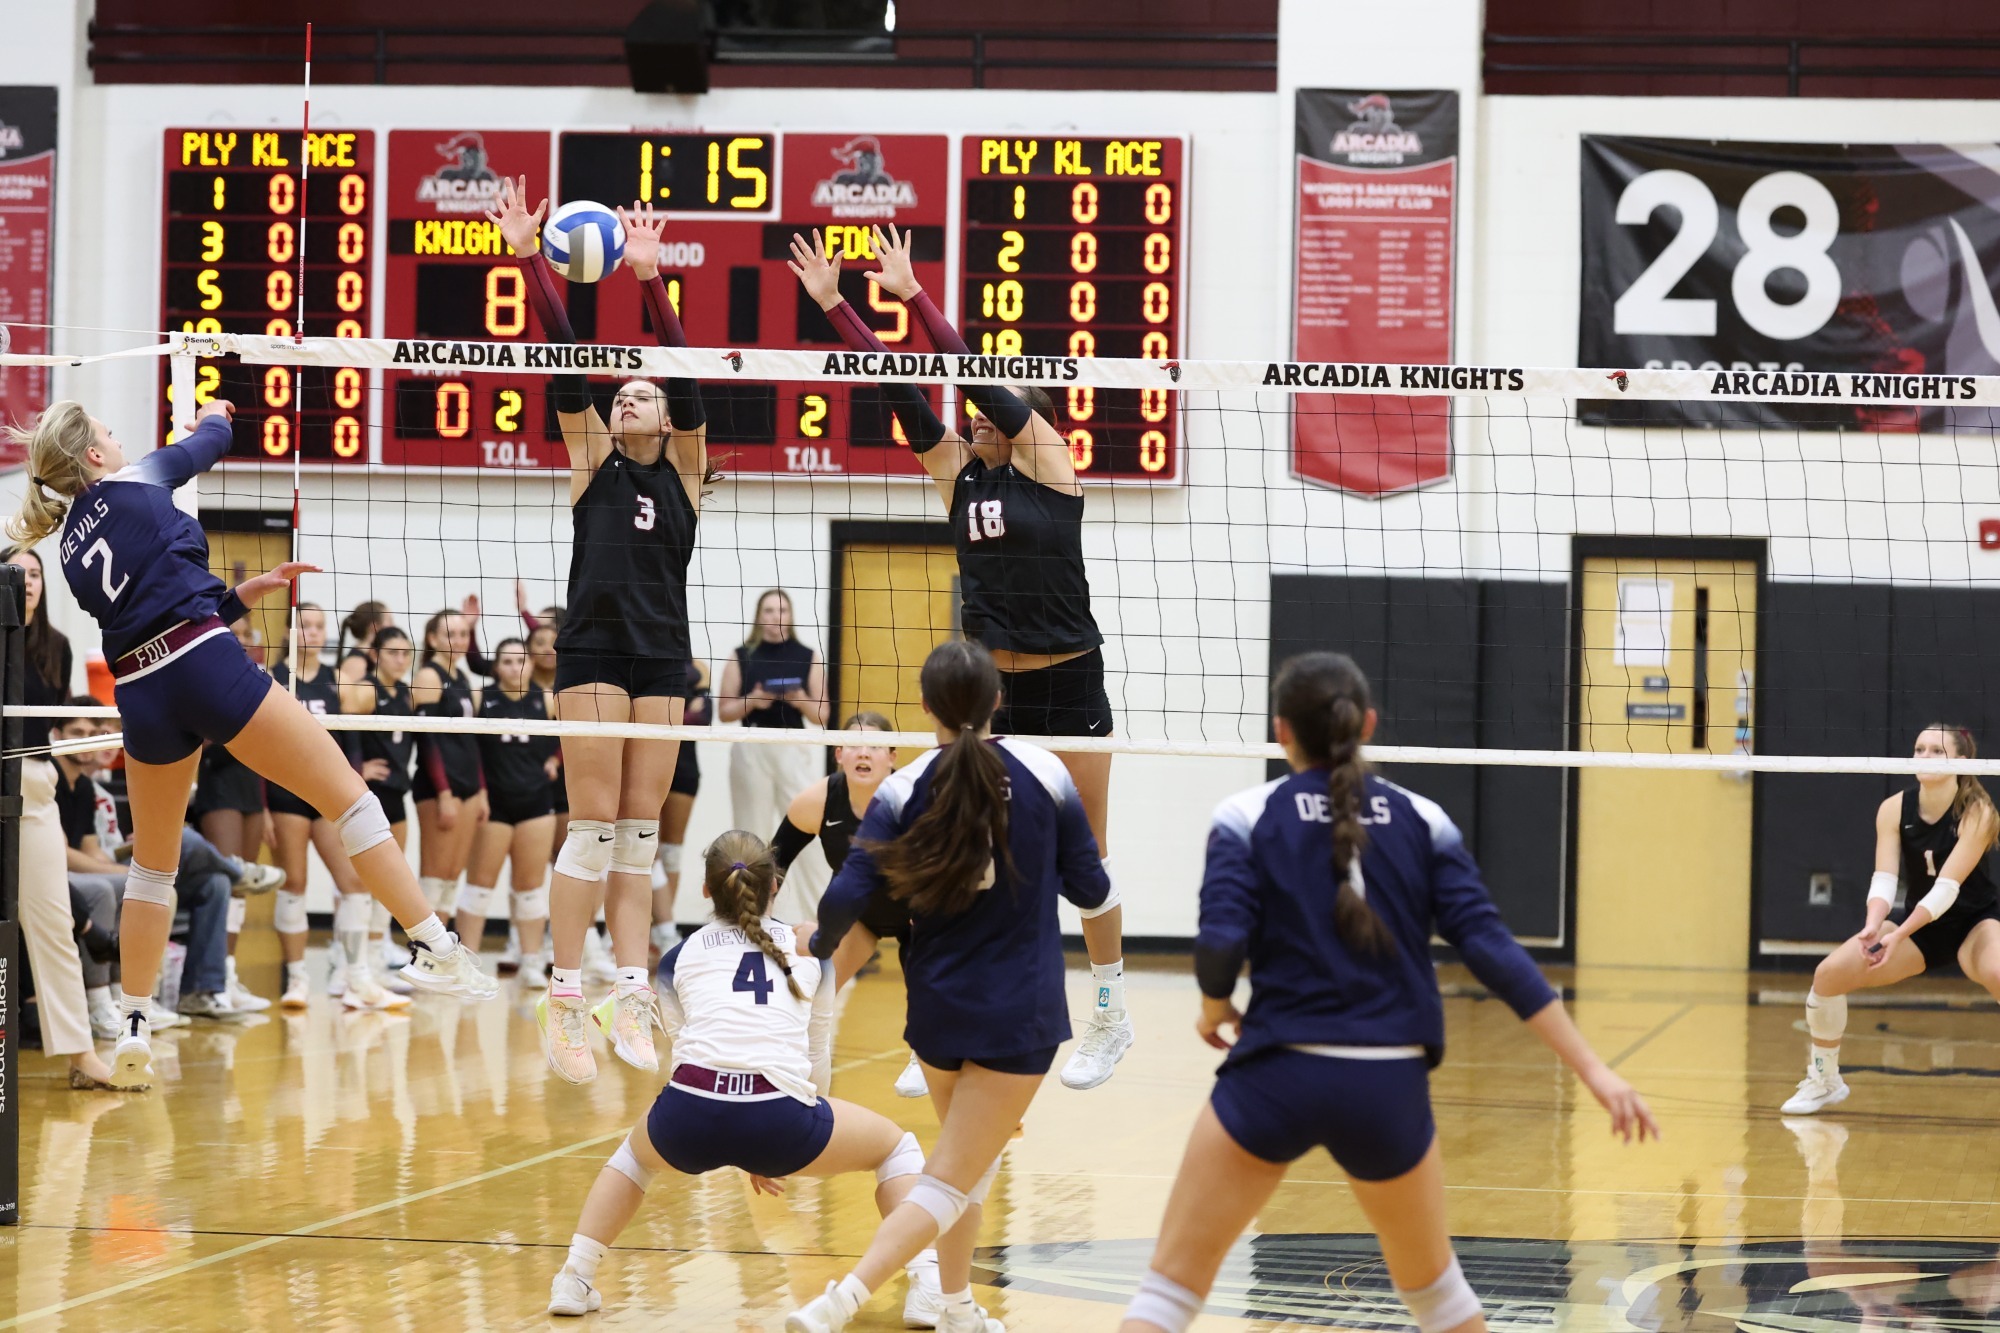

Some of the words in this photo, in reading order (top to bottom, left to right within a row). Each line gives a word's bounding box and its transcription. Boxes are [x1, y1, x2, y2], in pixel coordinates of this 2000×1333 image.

[183, 132, 237, 166] PLY
[252, 133, 288, 166] KL
[302, 133, 356, 167] ACE
[981, 140, 1037, 174] PLY
[1054, 141, 1092, 175] KL
[1106, 141, 1161, 176] ACE
[641, 138, 767, 208] 1:15
[813, 183, 917, 205] ARCADIA
[213, 176, 225, 210] 1
[269, 174, 295, 215] 0
[339, 174, 365, 216] 0
[1014, 185, 1025, 220] 1
[1072, 182, 1098, 224] 0
[1145, 183, 1171, 225] 0
[201, 221, 224, 262] 3
[268, 221, 294, 263] 0
[338, 222, 364, 264] 0
[415, 220, 541, 255] KNIGH
[657, 242, 705, 267] RIOD
[998, 230, 1025, 273] 2
[1071, 231, 1097, 273] 0
[1144, 232, 1170, 274] 0
[1614, 169, 1842, 340] 28
[197, 269, 223, 310] 5
[266, 270, 293, 311] 0
[337, 270, 363, 312] 0
[485, 266, 527, 337] 8
[867, 272, 909, 343] 5
[982, 279, 1024, 322] 10
[1070, 281, 1096, 323] 0
[1143, 282, 1169, 323] 0
[393, 341, 516, 366] ARCADIA
[524, 346, 643, 369] KNIGHTS
[823, 353, 949, 377] ARCADIA
[957, 356, 1079, 380] KNIGHTS
[265, 366, 291, 408] 0
[335, 367, 361, 409] 0
[1262, 363, 1391, 388] ARCADIA
[1400, 366, 1525, 391] KNIGHTS
[1711, 372, 1841, 396] ARCADIA
[1850, 375, 1977, 399] KNIGHTS
[436, 382, 470, 438] 0
[495, 390, 523, 433] 2
[799, 395, 827, 438] 2
[1068, 387, 1094, 422] 0
[1141, 388, 1168, 423] 0
[264, 415, 290, 456] 0
[334, 416, 360, 457] 0
[481, 441, 538, 467] T.O.L.
[1140, 430, 1167, 472] 0
[784, 447, 842, 472] T.O.L.
[60, 497, 110, 566] DEVILS
[634, 494, 656, 531] 3
[967, 499, 1006, 543] 18
[81, 537, 130, 604] 2
[134, 637, 171, 670] FDU
[1923, 849, 1936, 877] 1
[702, 927, 787, 950] DEVS
[732, 951, 774, 1005] 4
[713, 1071, 754, 1095] FDU
